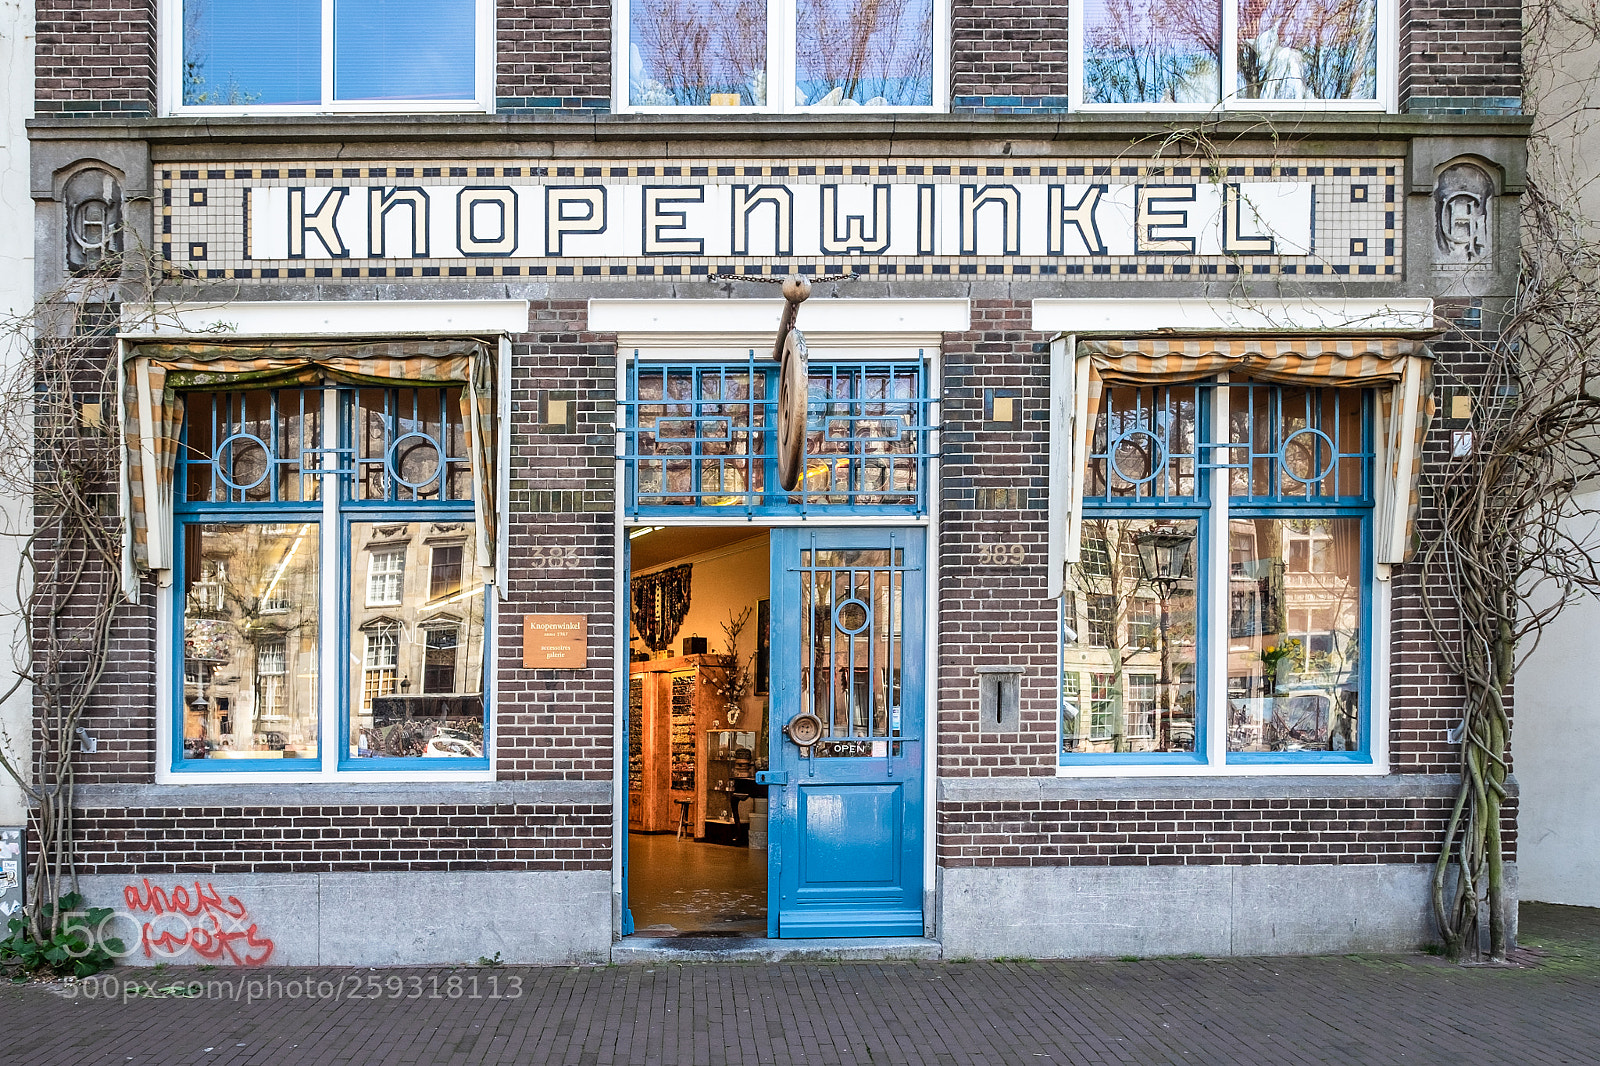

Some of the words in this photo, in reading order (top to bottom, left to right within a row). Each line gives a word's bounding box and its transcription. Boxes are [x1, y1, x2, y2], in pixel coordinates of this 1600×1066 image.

[288, 184, 1275, 259] KNOPENWINKEL
[531, 547, 580, 568] 383
[978, 544, 1025, 565] 389
[530, 622, 581, 631] Knopenwinkel
[546, 651, 565, 660] galerie
[833, 744, 865, 753] OPEN
